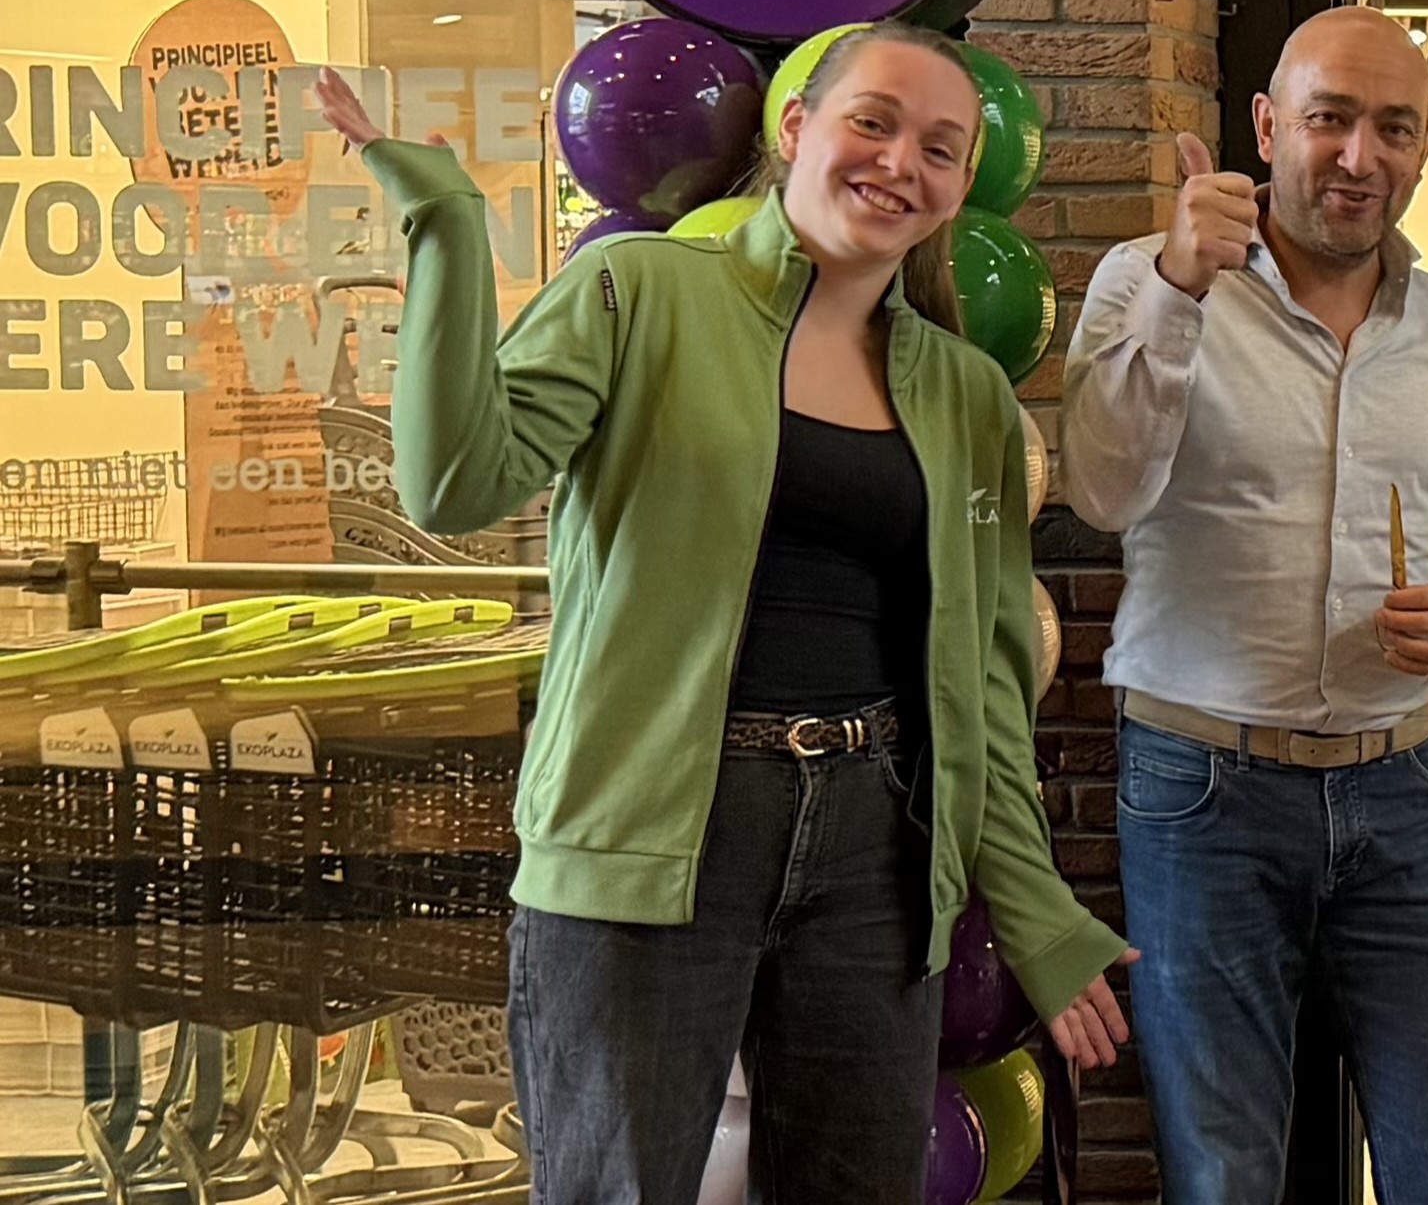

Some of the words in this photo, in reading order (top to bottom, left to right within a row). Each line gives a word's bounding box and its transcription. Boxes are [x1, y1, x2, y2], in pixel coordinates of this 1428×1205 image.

[151, 41, 278, 71] PRINCIPIEEL
[79, 449, 188, 491] niet
[45, 739, 115, 755] EKOPLAZA
[134, 740, 201, 756] EKOPLAZA
[236, 742, 306, 760] EKOPLAZA
